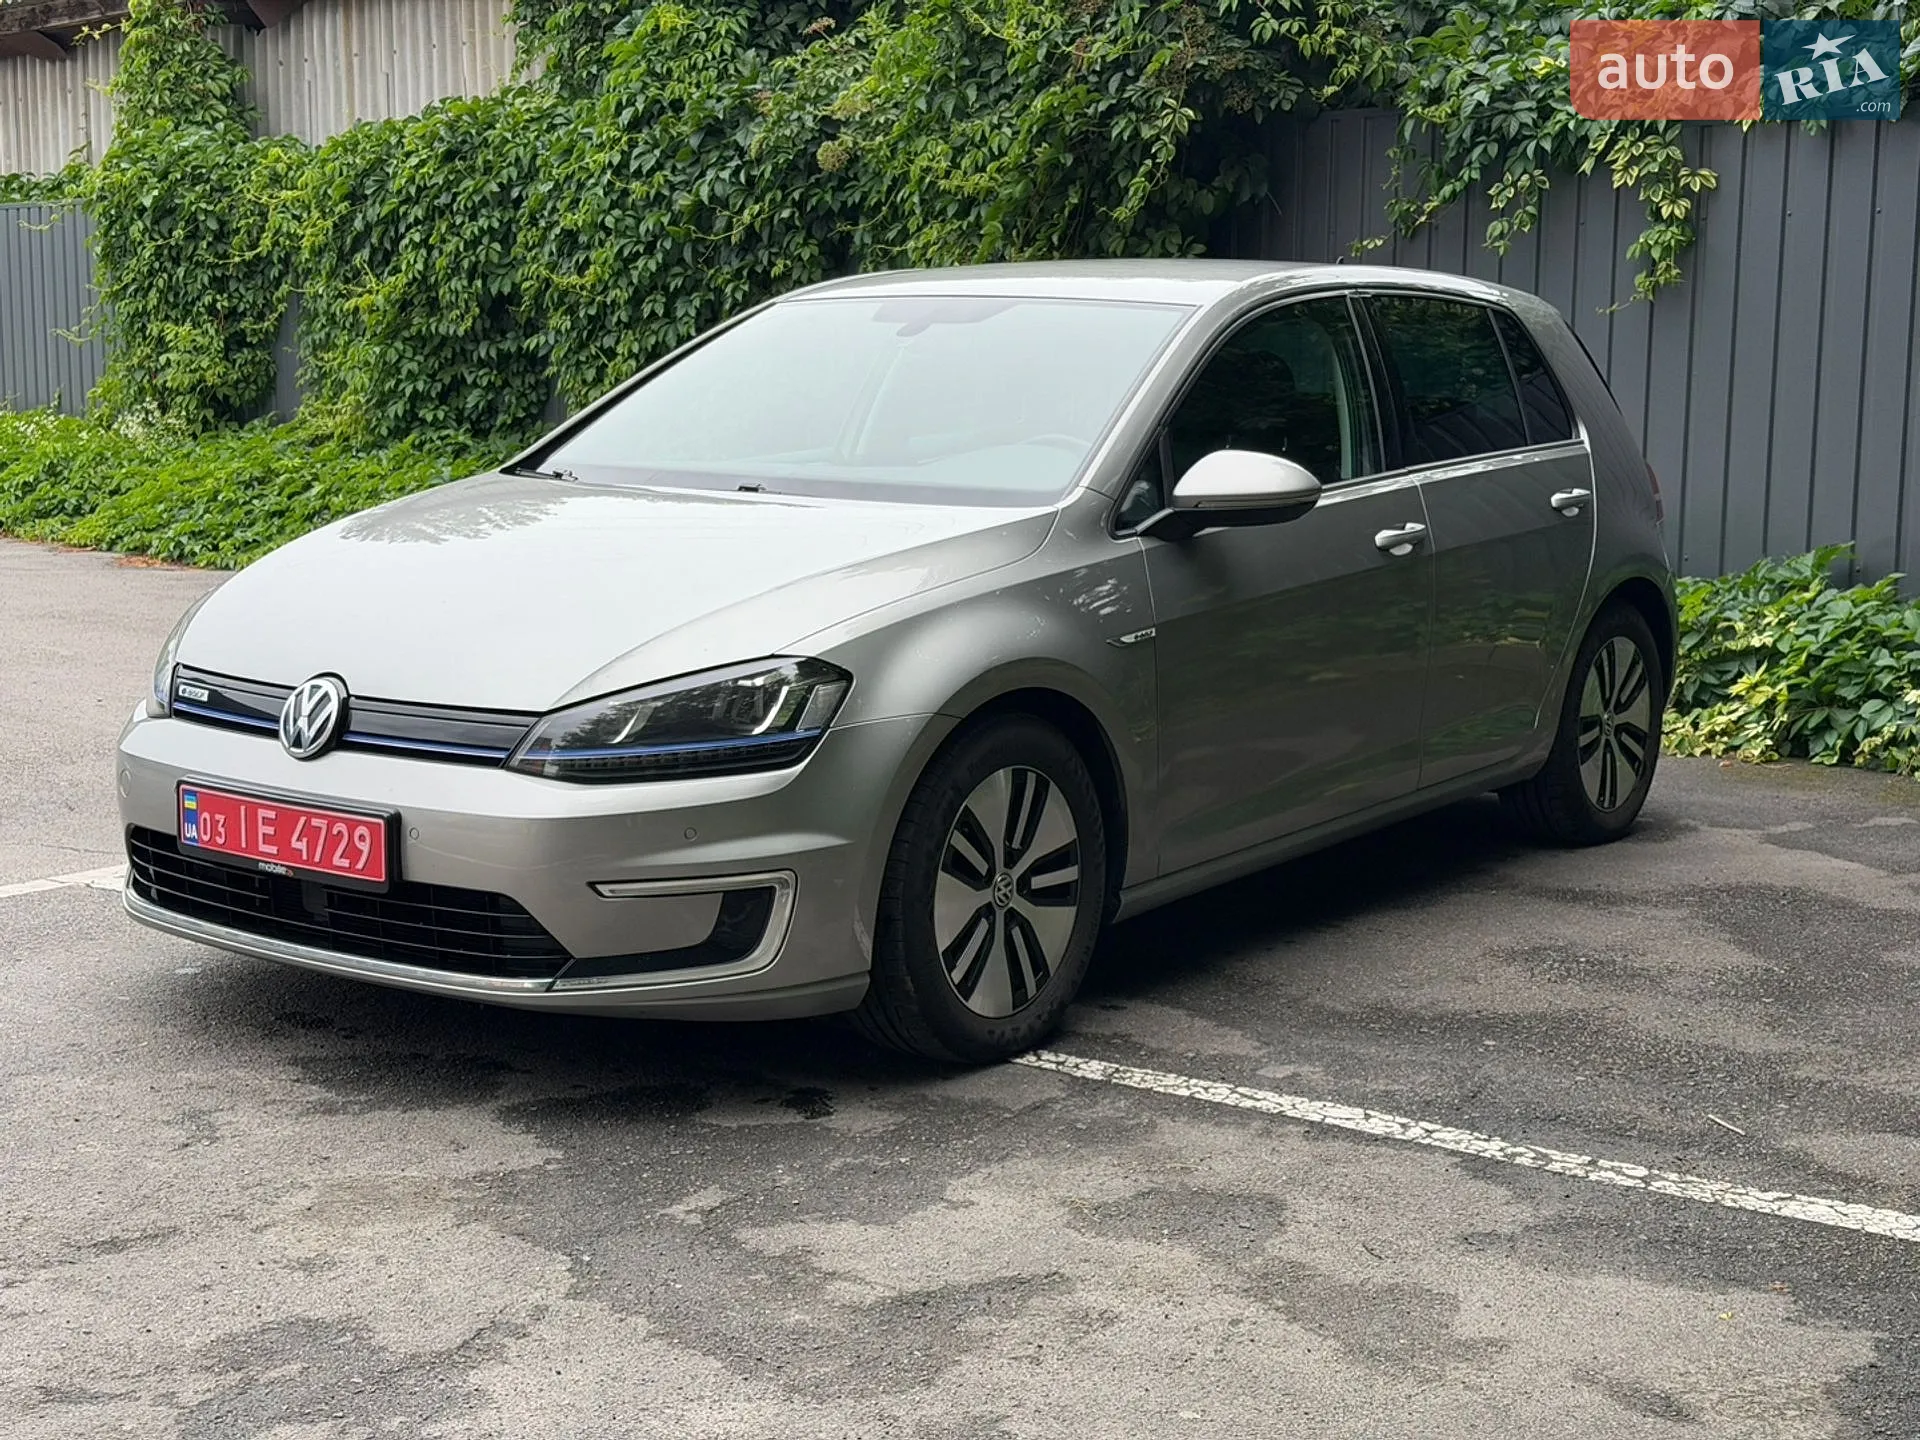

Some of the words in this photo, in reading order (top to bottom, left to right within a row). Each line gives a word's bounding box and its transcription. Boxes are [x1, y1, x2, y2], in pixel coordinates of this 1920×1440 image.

[184, 822, 198, 840] UA
[199, 812, 227, 845] 03
[239, 805, 278, 855] IE
[290, 816, 372, 870] 4729
